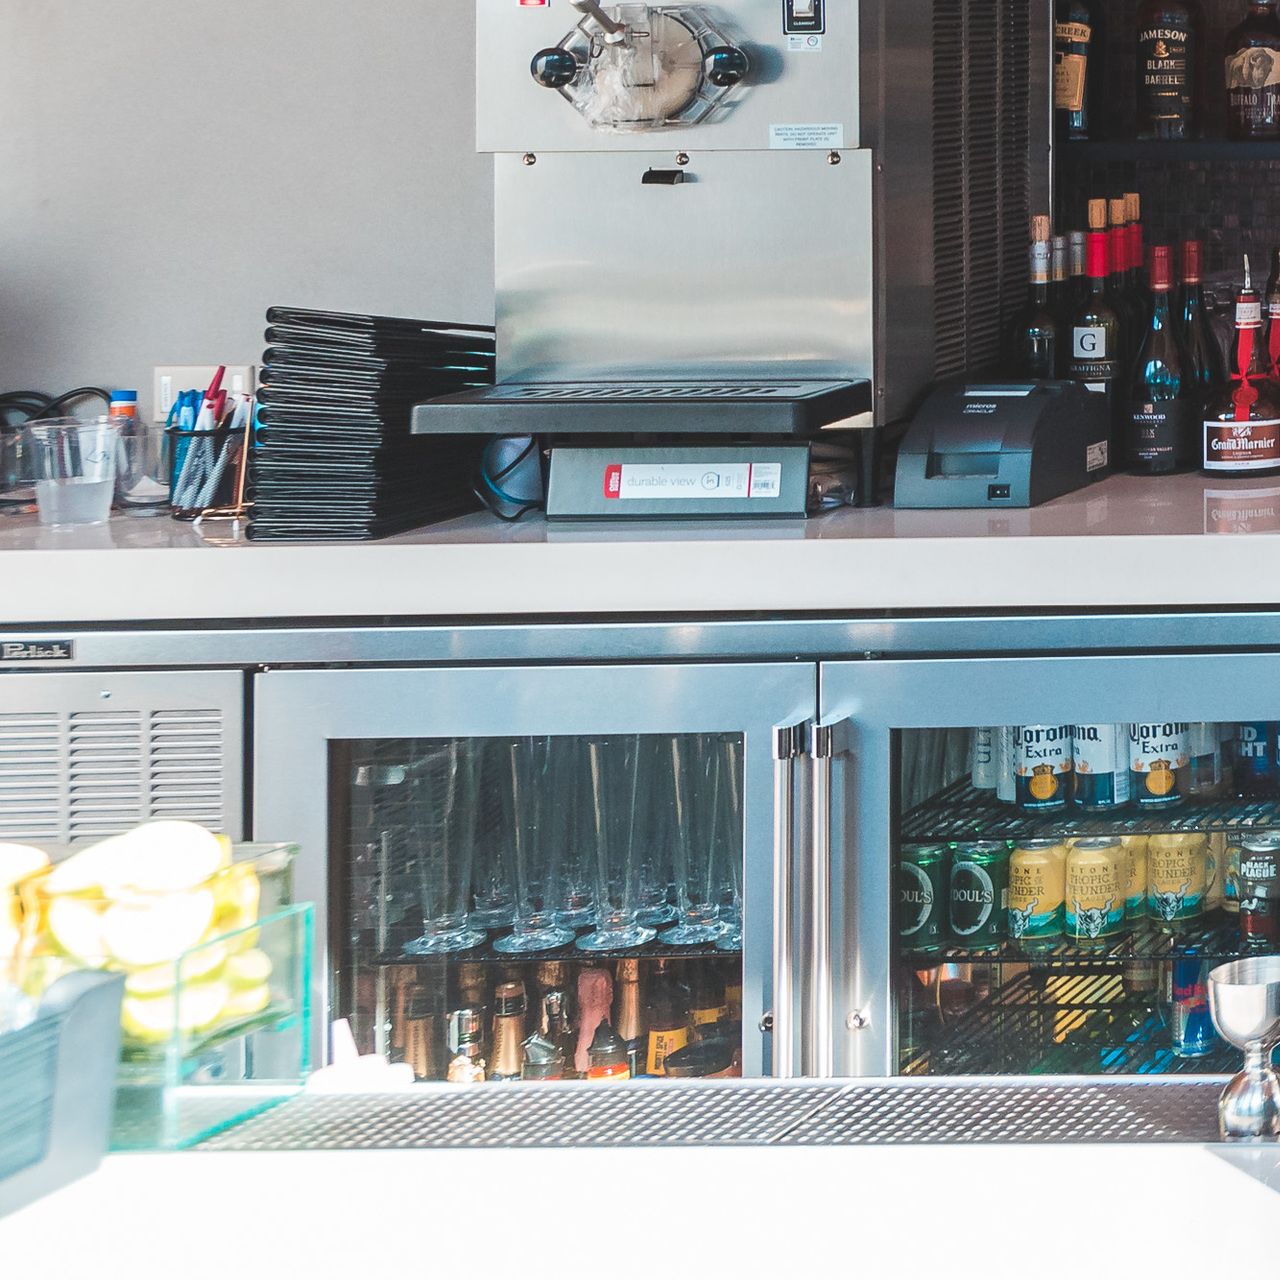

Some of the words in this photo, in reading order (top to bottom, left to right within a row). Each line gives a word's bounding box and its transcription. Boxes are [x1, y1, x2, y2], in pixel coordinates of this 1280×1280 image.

[1140, 28, 1187, 42] JAMESON
[1147, 59, 1176, 70] BLACK
[1144, 75, 1180, 85] BARREL
[1079, 333, 1096, 352] G
[1211, 437, 1237, 451] Grand
[1236, 437, 1276, 450] Marnier
[627, 475, 668, 488] durable
[670, 477, 696, 487] view
[1, 642, 69, 658] Perlick
[1025, 745, 1062, 758] Extra
[1141, 741, 1178, 754] Extra
[1246, 860, 1269, 869] BLACK
